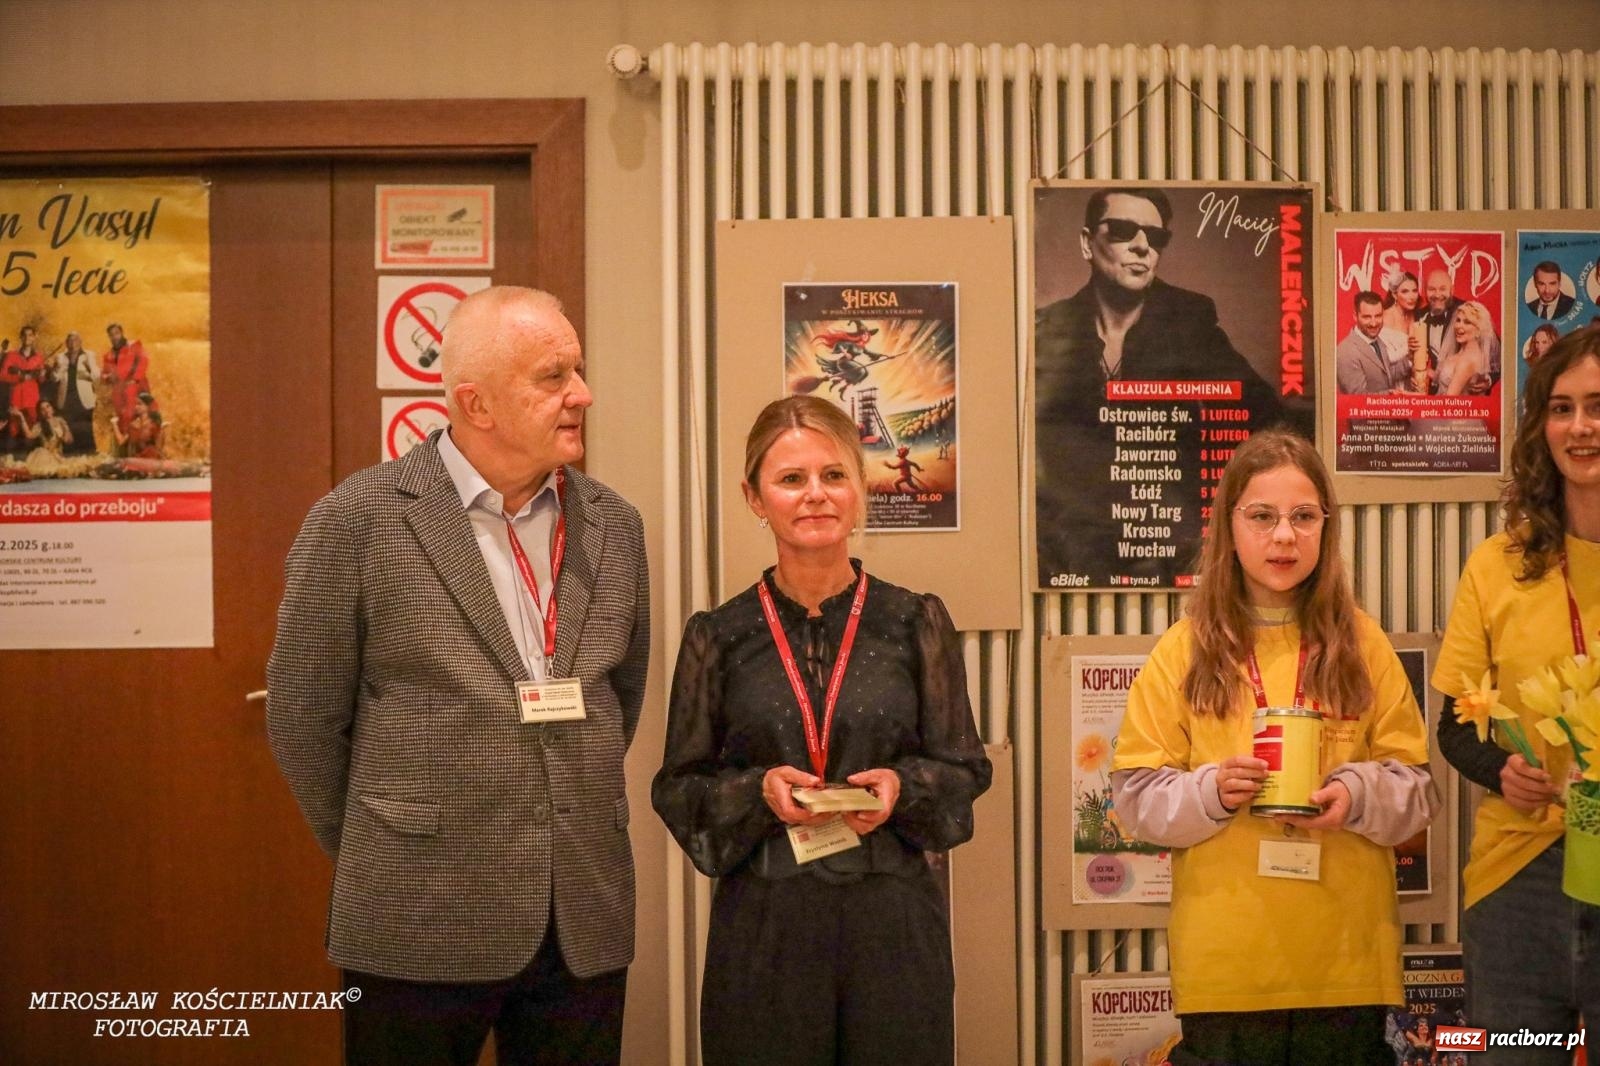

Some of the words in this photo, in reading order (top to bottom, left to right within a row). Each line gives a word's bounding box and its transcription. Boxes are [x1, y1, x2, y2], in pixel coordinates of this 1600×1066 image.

[38, 193, 162, 249] Vasyl
[1197, 191, 1280, 257] Maciej
[391, 228, 475, 237] MONITOROWANY
[1338, 240, 1500, 298] WSTYD
[841, 288, 899, 309] HEKSA
[1279, 205, 1308, 396] MALEŃCZUK
[1112, 383, 1173, 395] KLAUZULA
[1175, 383, 1233, 395] SUMIENIA
[1366, 397, 1409, 406] Raciborskie
[1411, 397, 1443, 406] Centrum
[1445, 397, 1473, 407] Kultury
[1099, 406, 1167, 422] Ostrowiec
[1171, 406, 1193, 422] św.
[1201, 410, 1206, 421] 1
[1209, 409, 1249, 421] LUTEGO
[1349, 409, 1357, 417] 18
[1360, 408, 1390, 418] stycznia
[1392, 408, 1413, 417] 2025r
[1420, 408, 1441, 418] godz.
[1443, 408, 1464, 417] 16.00
[1469, 408, 1490, 417] 18.30
[1115, 425, 1176, 441] Racibórz
[1201, 429, 1207, 441] 7
[1210, 429, 1249, 441] LUTEGO
[1353, 424, 1379, 433] Wojciech
[1341, 433, 1362, 442] Anna
[1364, 433, 1416, 442] Dereszowska
[1425, 434, 1456, 443] Marieta
[1457, 432, 1497, 443] Żukowska
[1114, 446, 1177, 462] Jaworzno
[1201, 450, 1207, 461] 8
[1341, 443, 1372, 454] Szymon
[1374, 443, 1417, 453] Bobrowski
[1425, 444, 1460, 454] Wojciech
[1462, 442, 1495, 453] Zieliński
[1110, 465, 1182, 481] Radomsko
[1201, 468, 1207, 479] 9
[890, 493, 913, 503] godz.
[916, 493, 943, 502] 16.00
[1131, 484, 1162, 500] Łódź
[54, 499, 76, 515] do
[1112, 503, 1147, 522] Nowy
[1151, 503, 1182, 522] Targ
[1123, 523, 1171, 539] Krosno
[1118, 541, 1177, 558] Wrocław
[1050, 573, 1090, 587] eBilet
[1409, 1003, 1437, 1015] 2025
